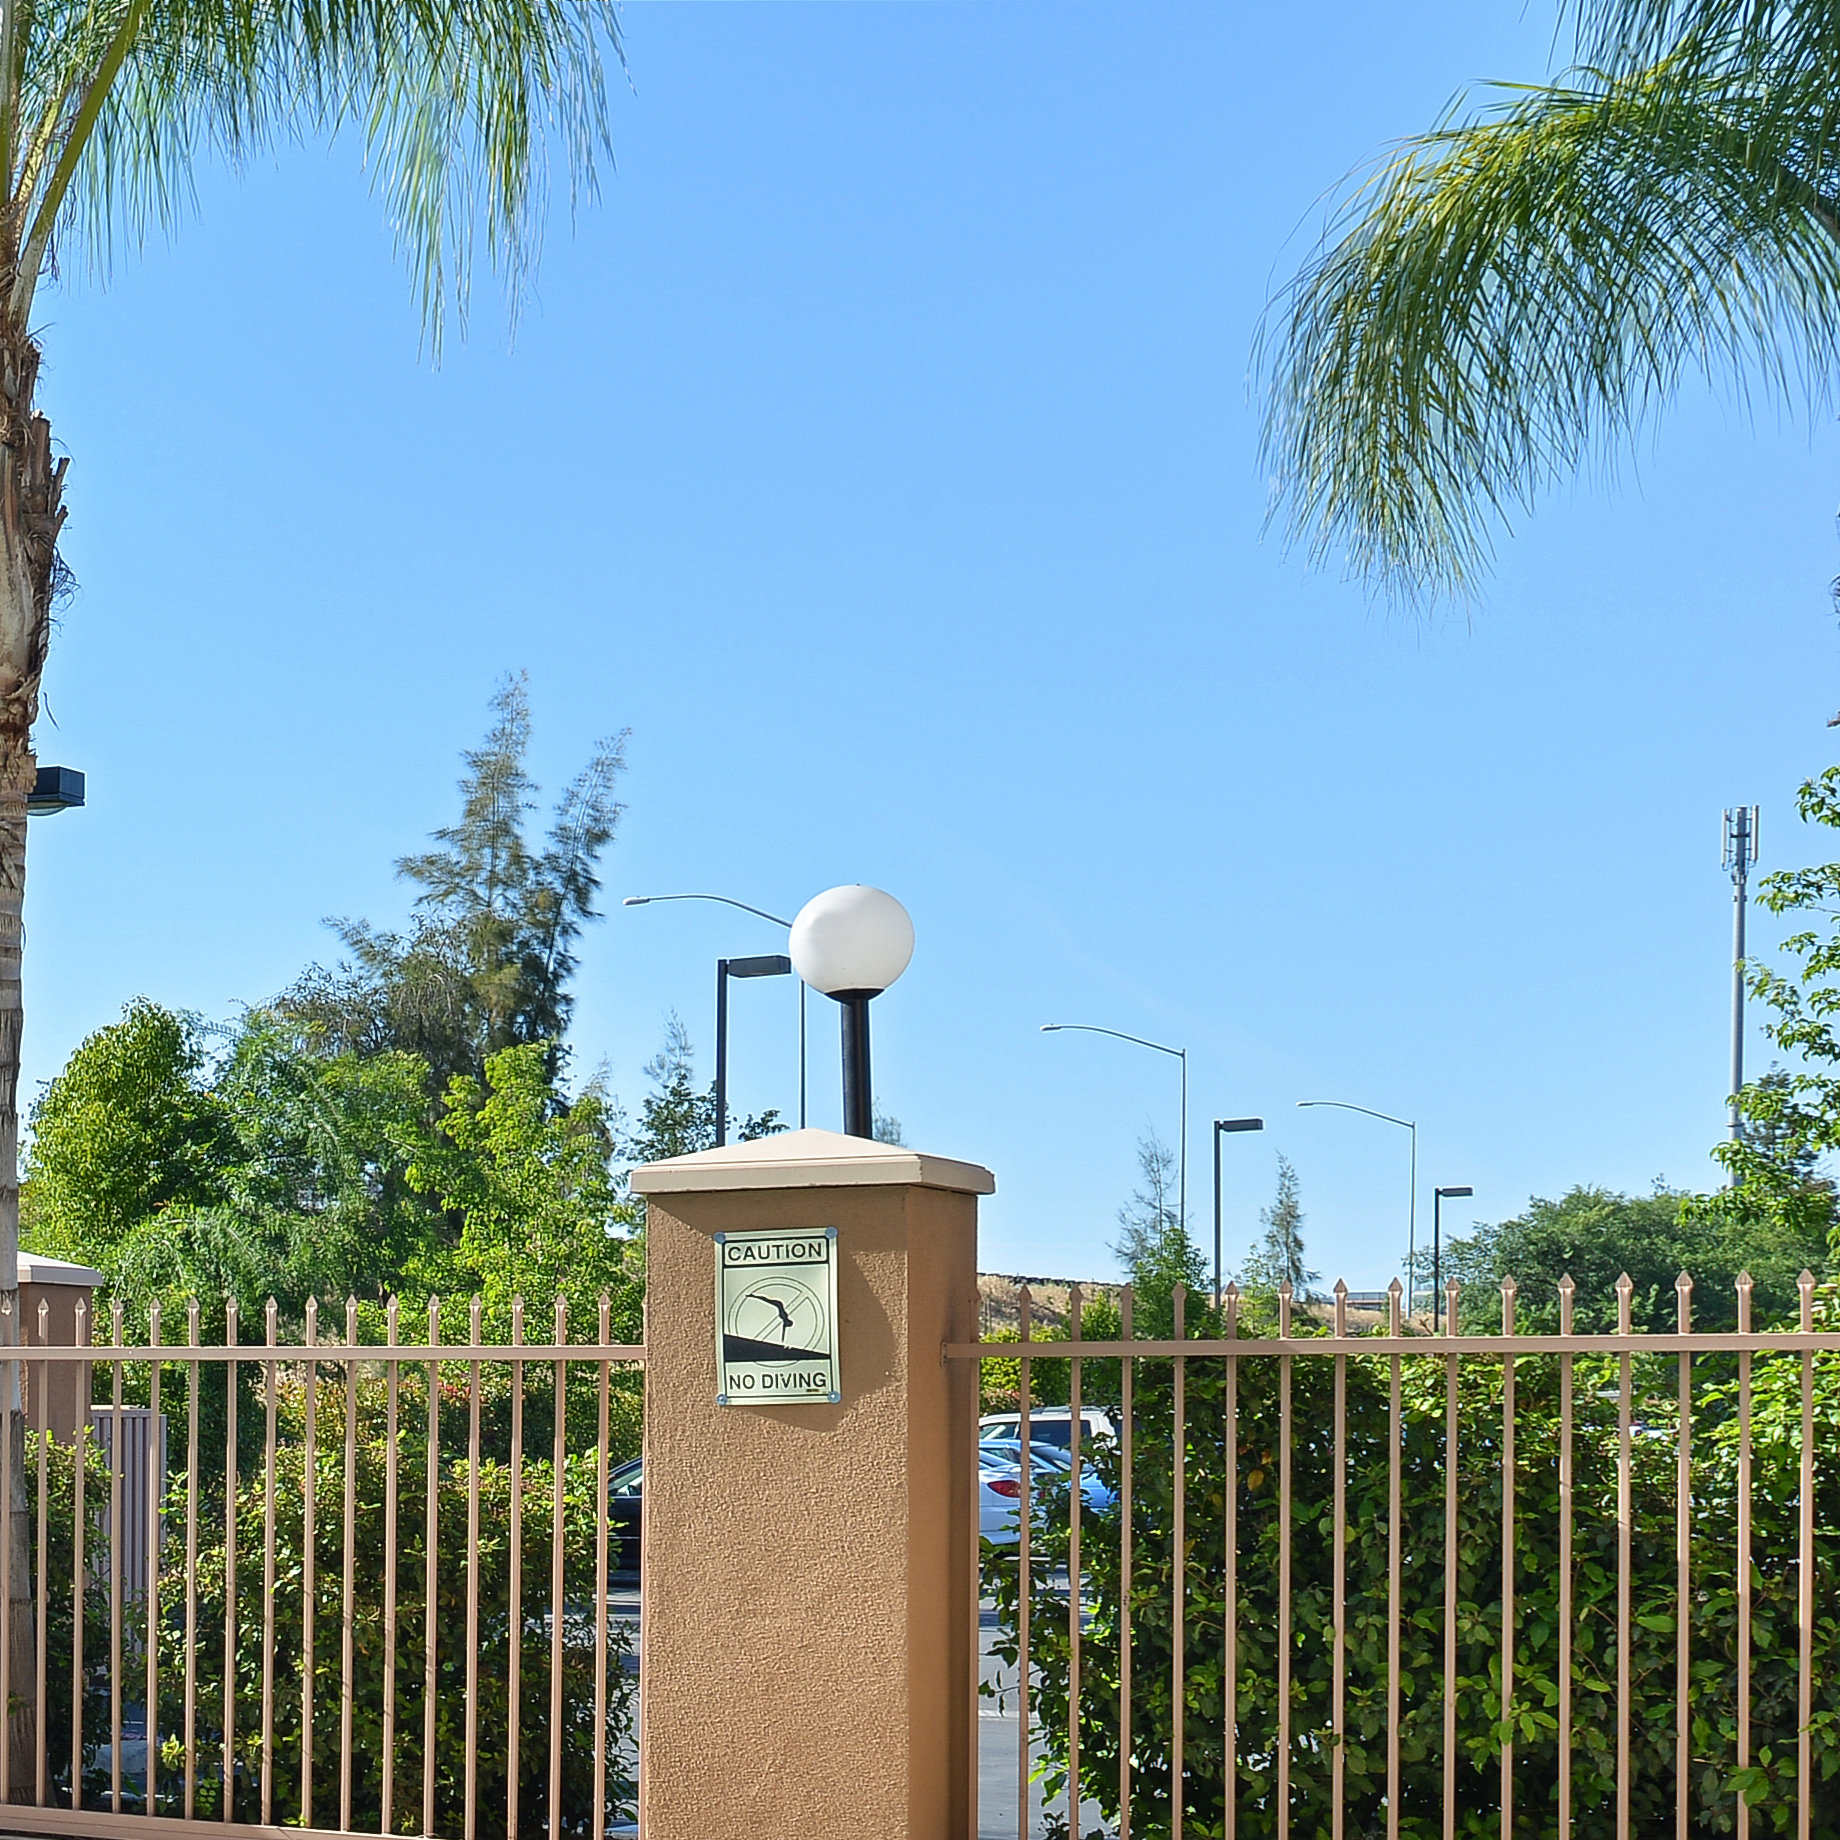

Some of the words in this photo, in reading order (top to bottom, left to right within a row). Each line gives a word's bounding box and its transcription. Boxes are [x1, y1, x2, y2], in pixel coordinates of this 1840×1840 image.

[727, 1242, 823, 1262] CAUTION
[728, 1373, 756, 1391] NO
[762, 1371, 827, 1390] DIVING
